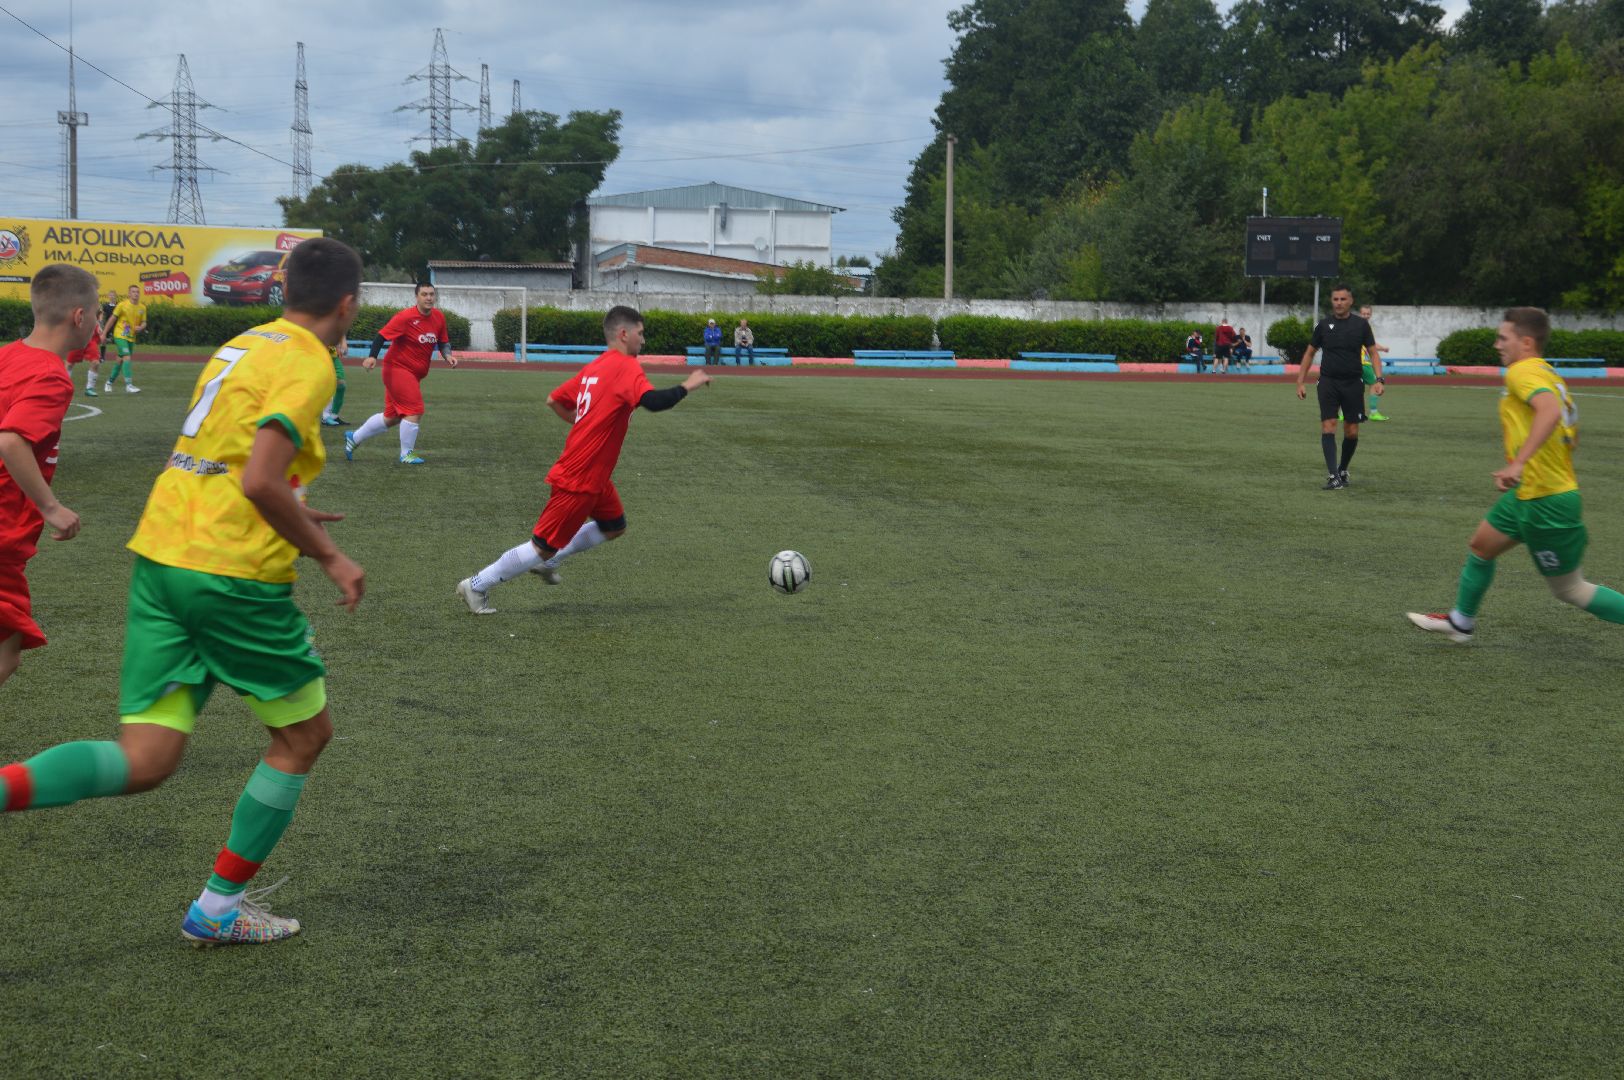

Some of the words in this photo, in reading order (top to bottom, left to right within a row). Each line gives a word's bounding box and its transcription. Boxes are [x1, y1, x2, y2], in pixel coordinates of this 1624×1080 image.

[43, 226, 185, 249] АВТОШКОЛА
[153, 280, 182, 291] 5000
[181, 345, 250, 439] 7
